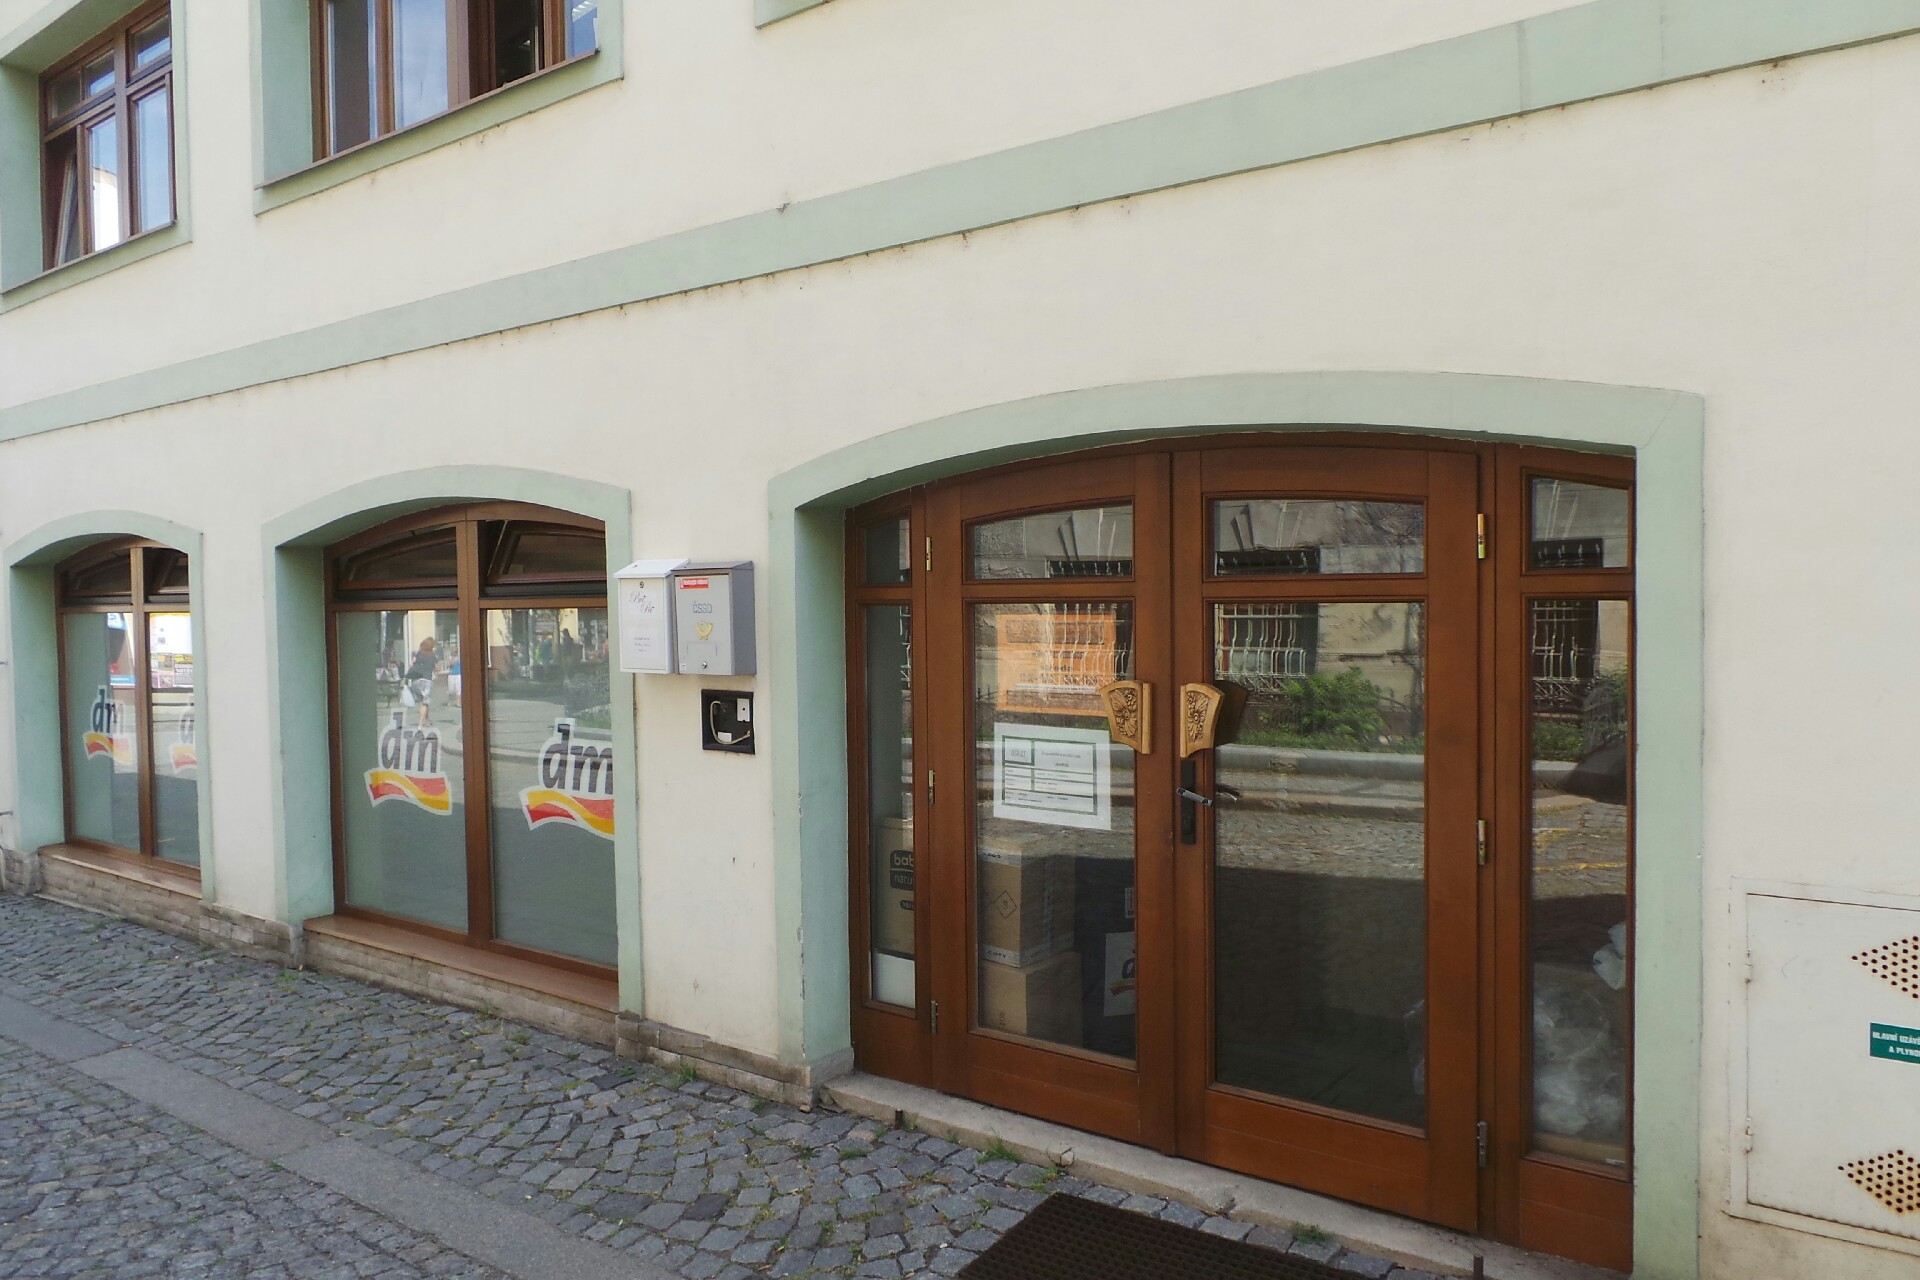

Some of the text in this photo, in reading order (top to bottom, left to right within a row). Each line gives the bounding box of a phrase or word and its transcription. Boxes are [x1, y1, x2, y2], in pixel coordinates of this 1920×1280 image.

[92, 688, 124, 734] dm
[381, 711, 440, 774] dm
[542, 723, 613, 795] dm
[987, 950, 1007, 959] COTY
[1872, 1031, 1920, 1045] HLAVNÍ UZÁVĚ
[1896, 1047, 1920, 1057] PLYNO
